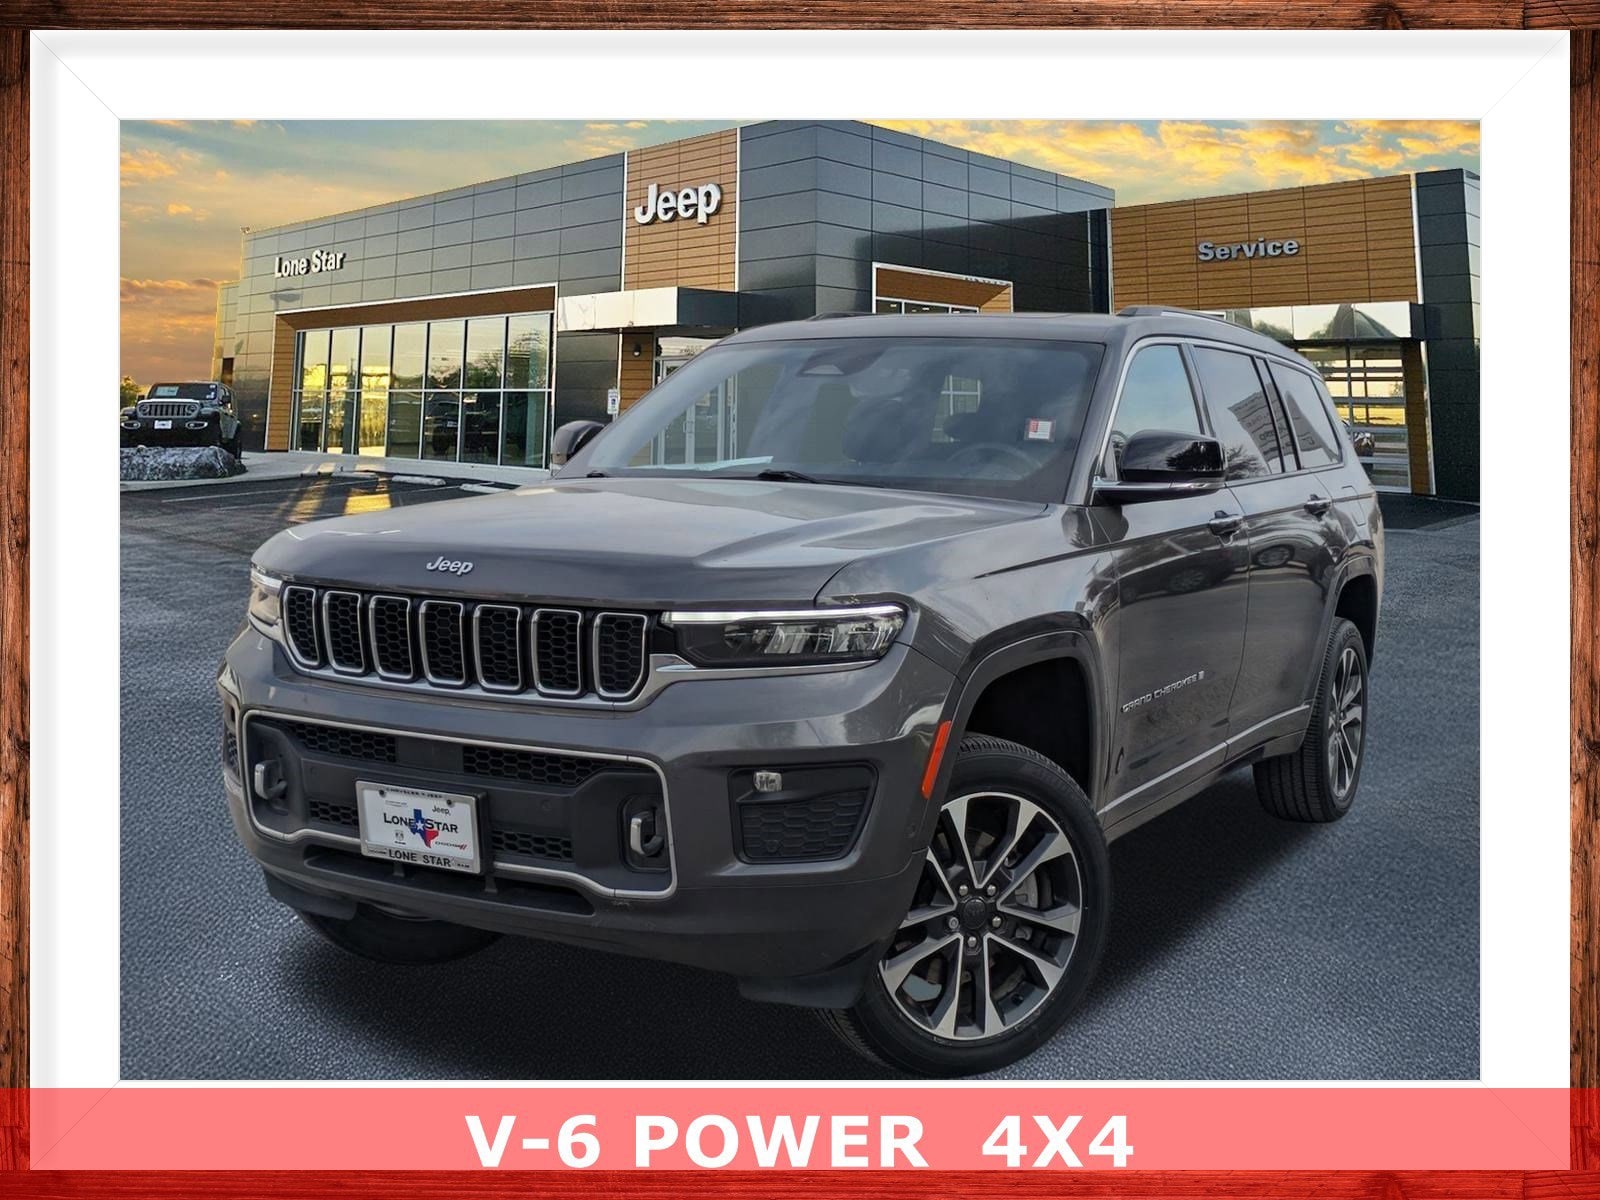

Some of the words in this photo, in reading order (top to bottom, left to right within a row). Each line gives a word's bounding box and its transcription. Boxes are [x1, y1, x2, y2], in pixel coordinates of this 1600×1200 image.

[634, 183, 722, 224] Jeep
[1198, 237, 1299, 261] Service
[275, 257, 310, 278] Lone
[311, 249, 346, 273] Star
[426, 556, 473, 575] Jeep
[1122, 693, 1152, 713] GRAND
[432, 805, 449, 815] Jeep
[383, 812, 416, 828] LONE
[424, 818, 459, 834] STAR
[388, 849, 417, 862] LONE
[422, 854, 451, 867] STAR
